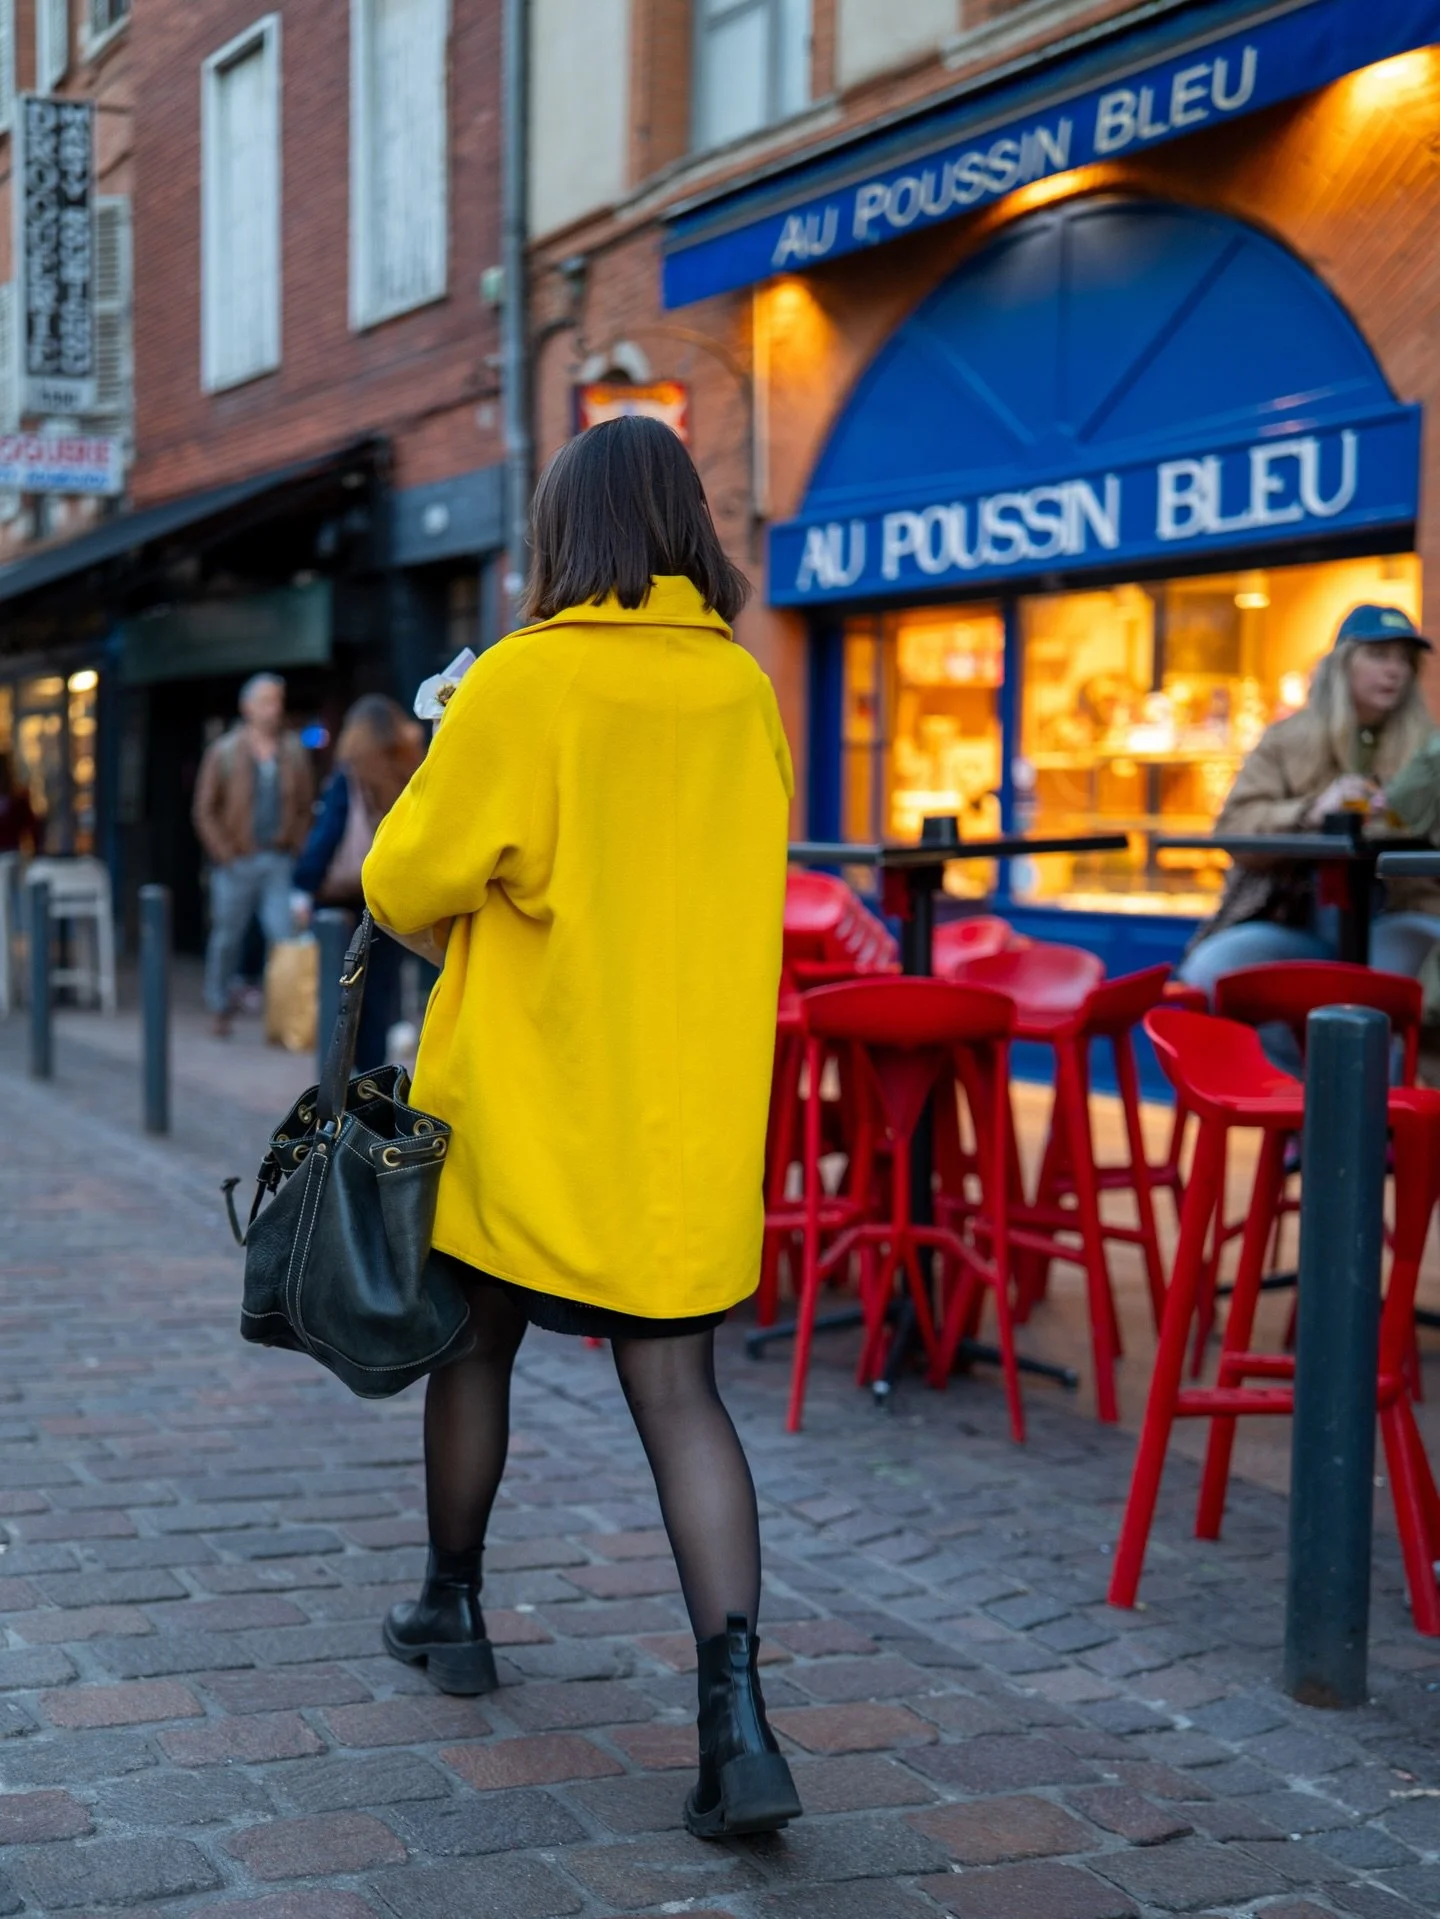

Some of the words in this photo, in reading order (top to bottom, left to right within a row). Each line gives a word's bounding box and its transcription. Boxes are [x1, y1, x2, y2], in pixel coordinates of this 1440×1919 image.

[771, 205, 839, 268] AU
[852, 117, 1073, 240] POUSSIN
[1094, 45, 1258, 155] BLEU
[796, 519, 867, 592] AU
[881, 474, 1120, 581] POUSSIN
[1156, 428, 1359, 541] BLEU
